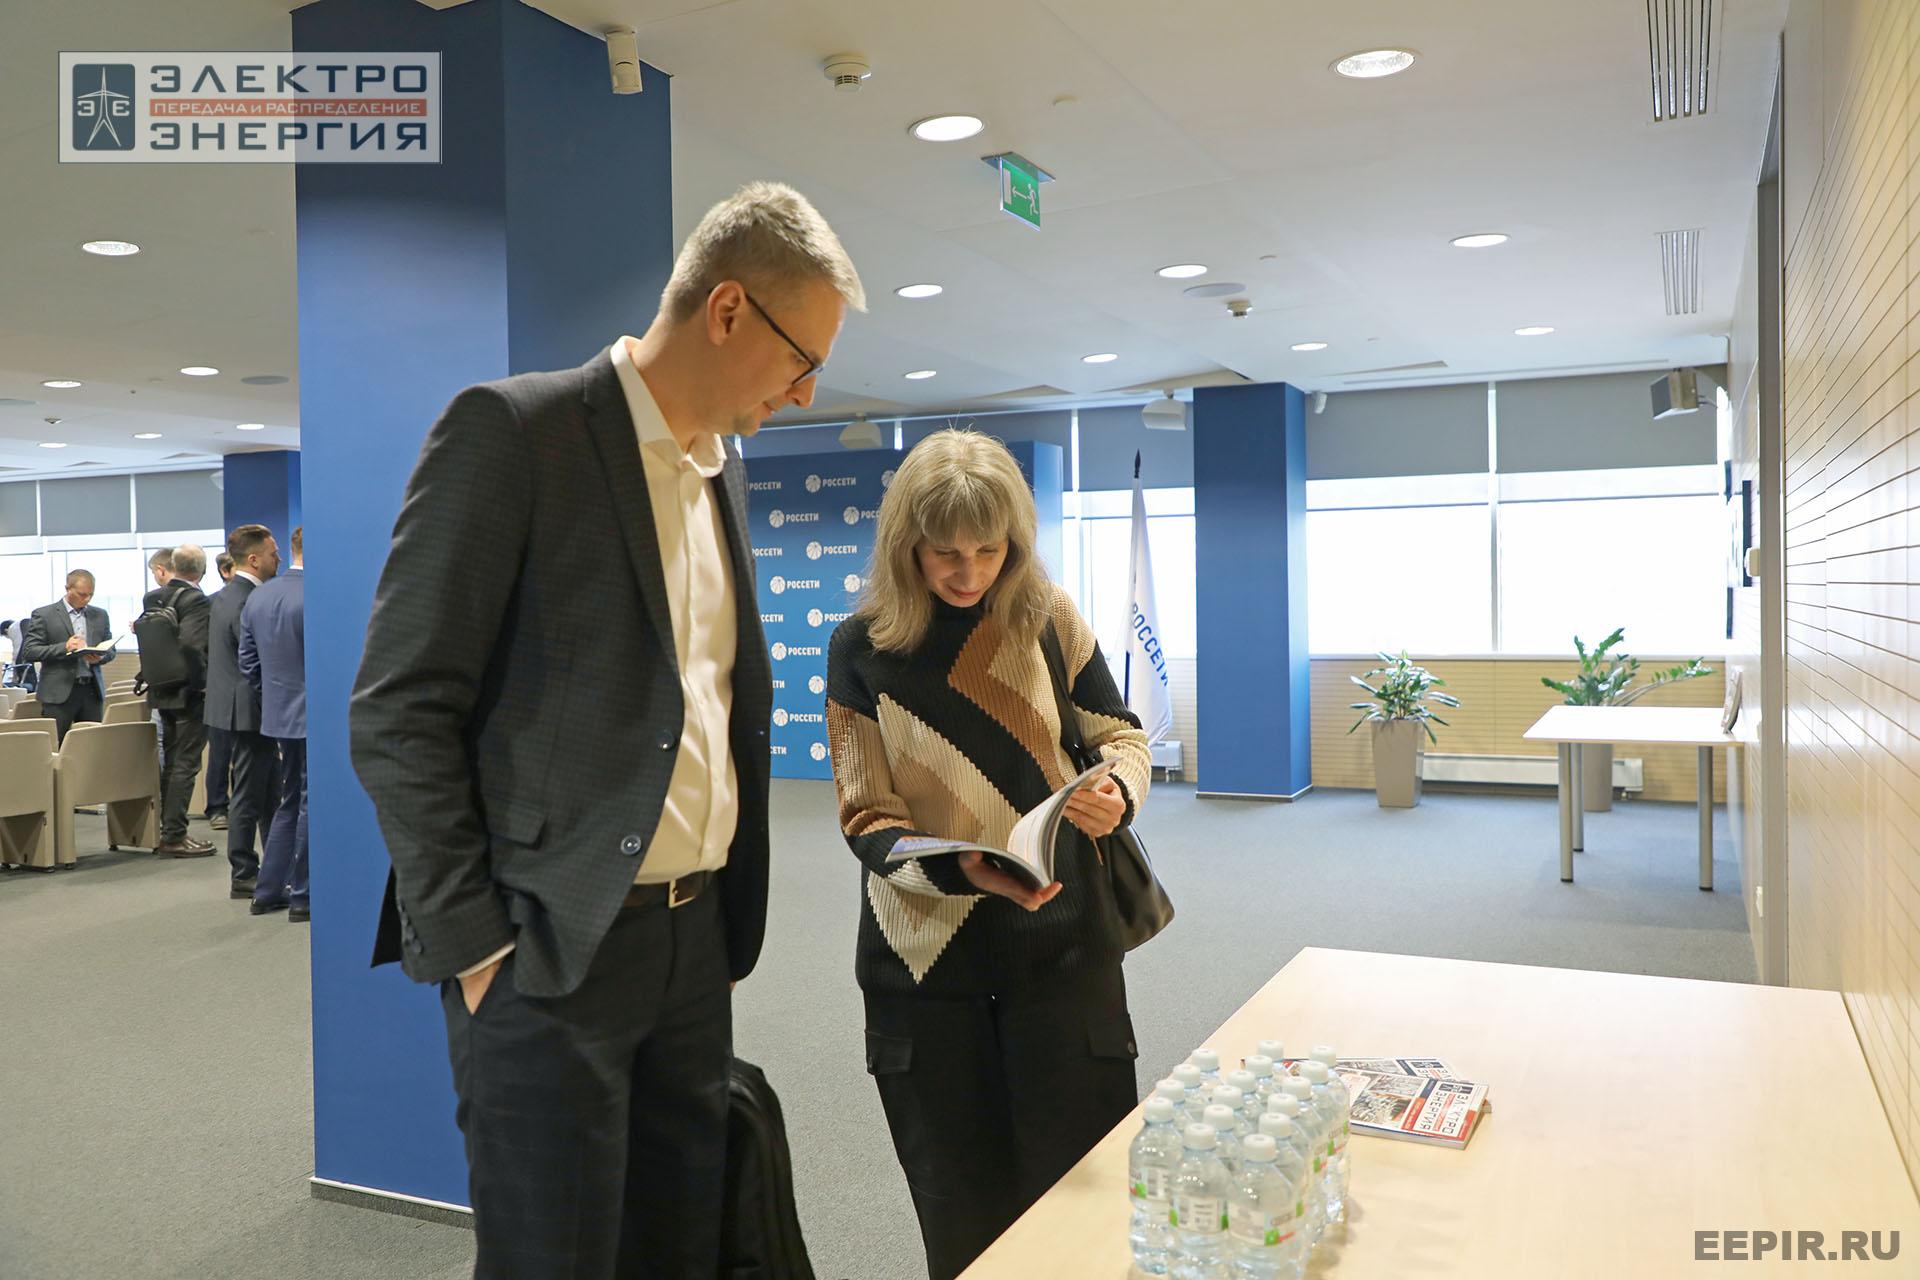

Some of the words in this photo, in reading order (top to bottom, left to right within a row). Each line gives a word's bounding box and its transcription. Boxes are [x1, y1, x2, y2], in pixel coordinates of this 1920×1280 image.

[749, 481, 781, 490] РОССЕТИ
[822, 477, 857, 487] РОССЕТИ
[786, 513, 819, 522] РОССЕТИ
[823, 545, 857, 555] РОССЕТИ
[786, 580, 820, 589] РОССЕТИ
[760, 614, 784, 623] ССЕТИ
[788, 647, 821, 656] РОССЕТИ
[789, 713, 823, 723] РОССЕТИ
